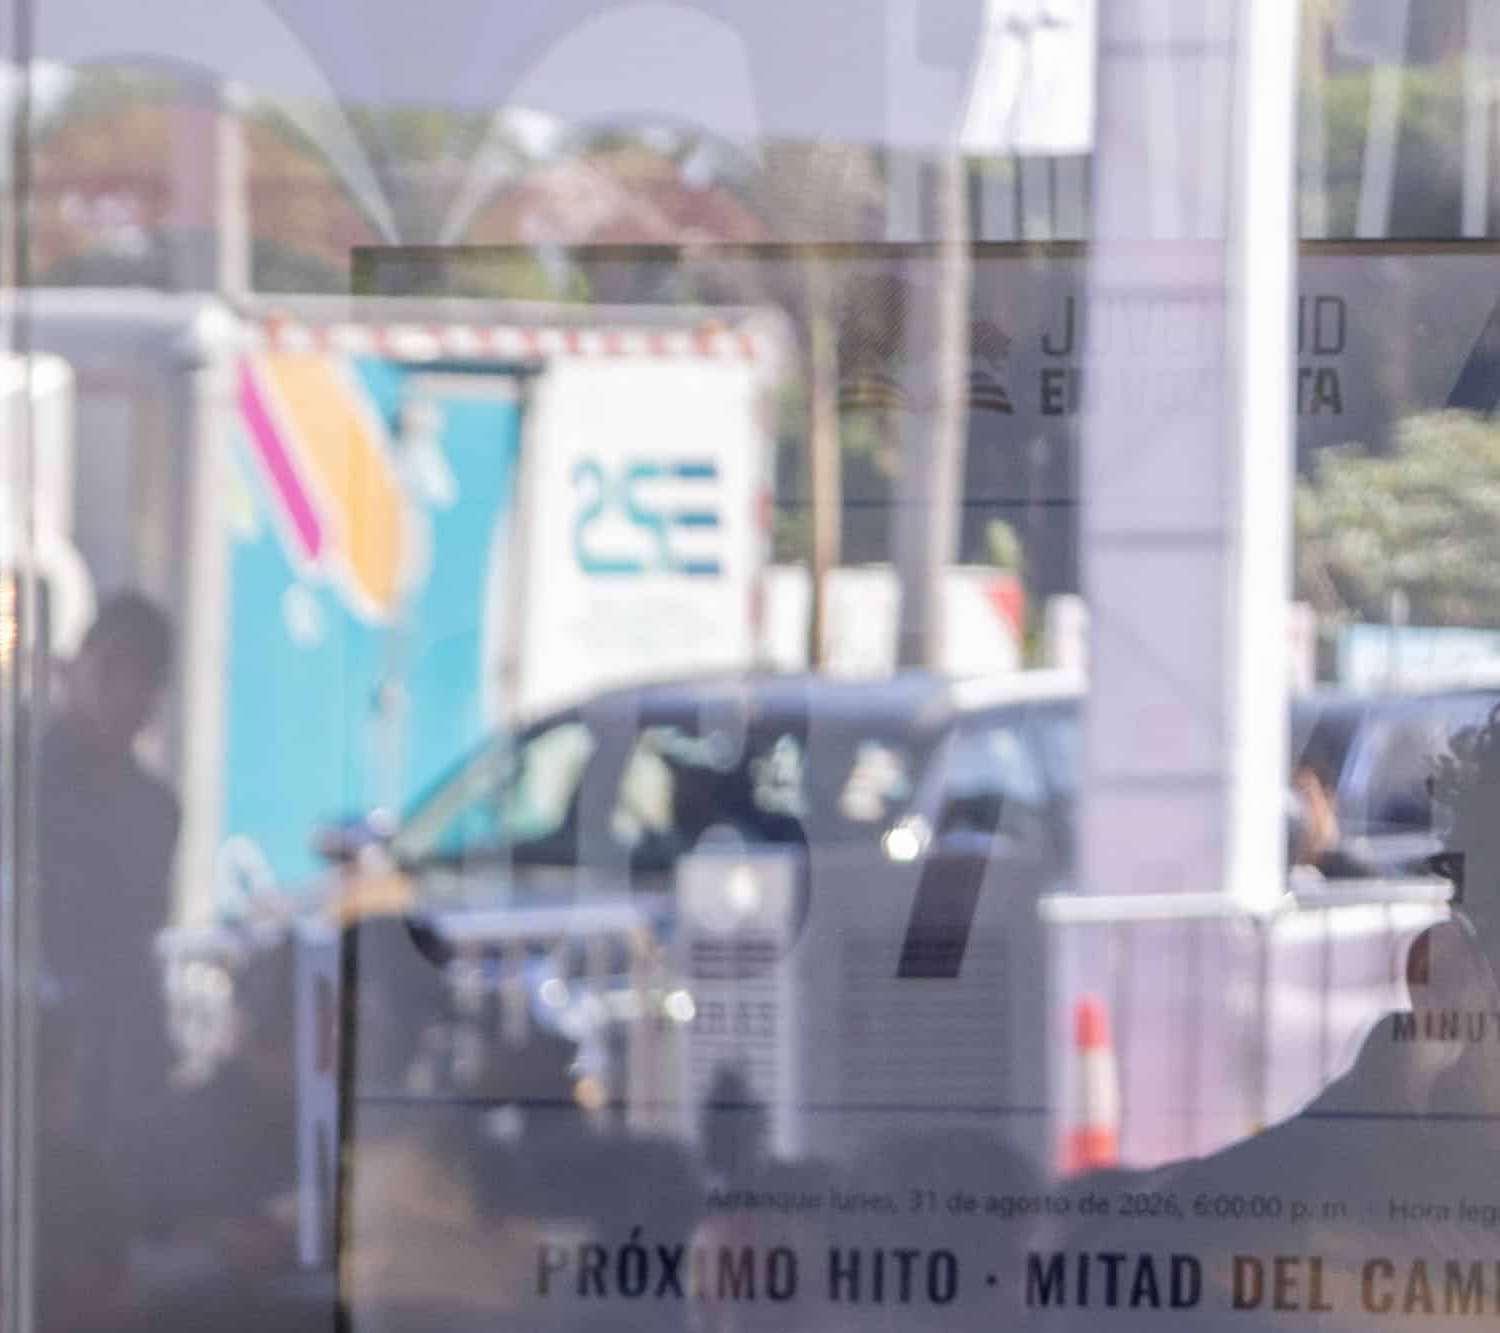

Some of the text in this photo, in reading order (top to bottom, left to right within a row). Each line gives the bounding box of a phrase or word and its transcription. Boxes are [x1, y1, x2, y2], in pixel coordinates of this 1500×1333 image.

[907, 1189, 934, 1212] 31
[945, 1189, 976, 1214] de
[984, 1192, 1068, 1219] agosto
[1077, 1191, 1109, 1217] de
[536, 1225, 1500, 1317] PRÓXIMO HITO MITAD DEL CAM
